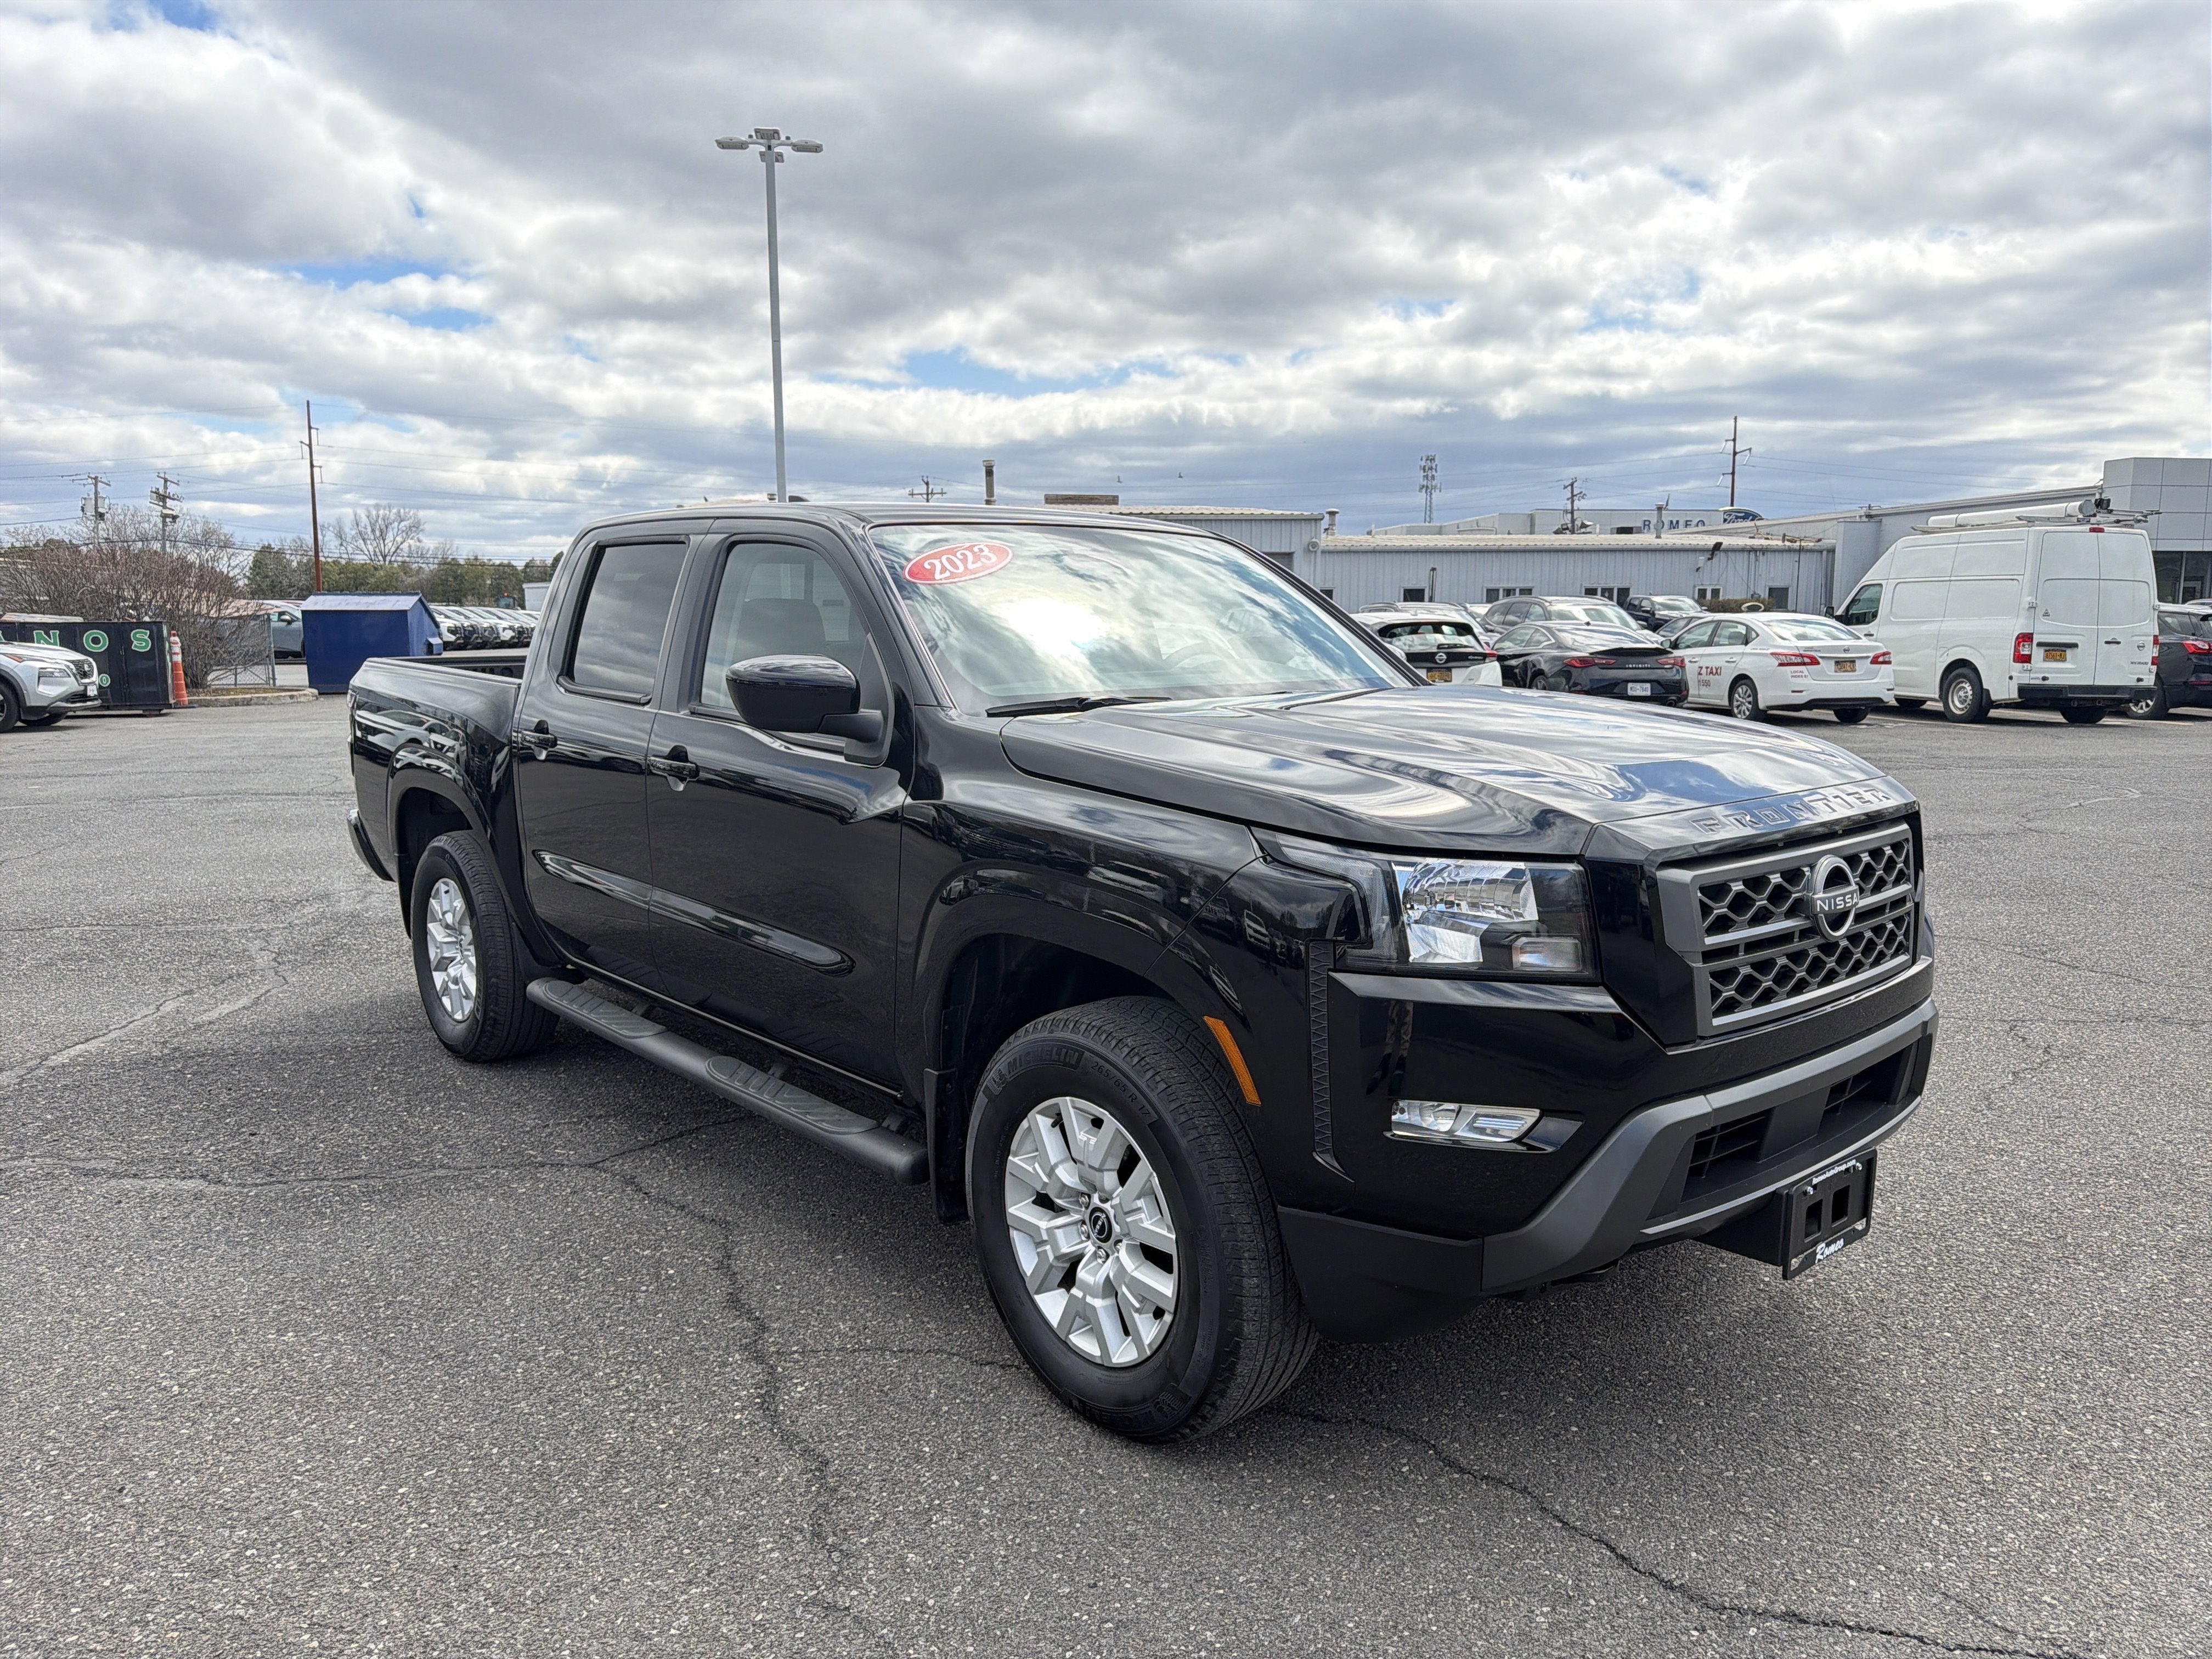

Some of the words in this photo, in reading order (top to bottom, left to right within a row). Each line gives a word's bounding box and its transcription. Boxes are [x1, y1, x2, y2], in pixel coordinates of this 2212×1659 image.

[923, 544, 997, 580] 2023
[0, 629, 151, 652] NOS
[1699, 667, 1703, 675] Z
[1705, 667, 1722, 676] TAXI
[1689, 788, 1893, 834] FRONTIER
[1817, 893, 1858, 911] NISSA
[1007, 1047, 1081, 1074] MICHELIN
[1091, 1060, 1127, 1093] 265/65
[1128, 1093, 1138, 1103] R
[1138, 1104, 1150, 1116] 17
[1815, 1238, 1844, 1264] Romeo
